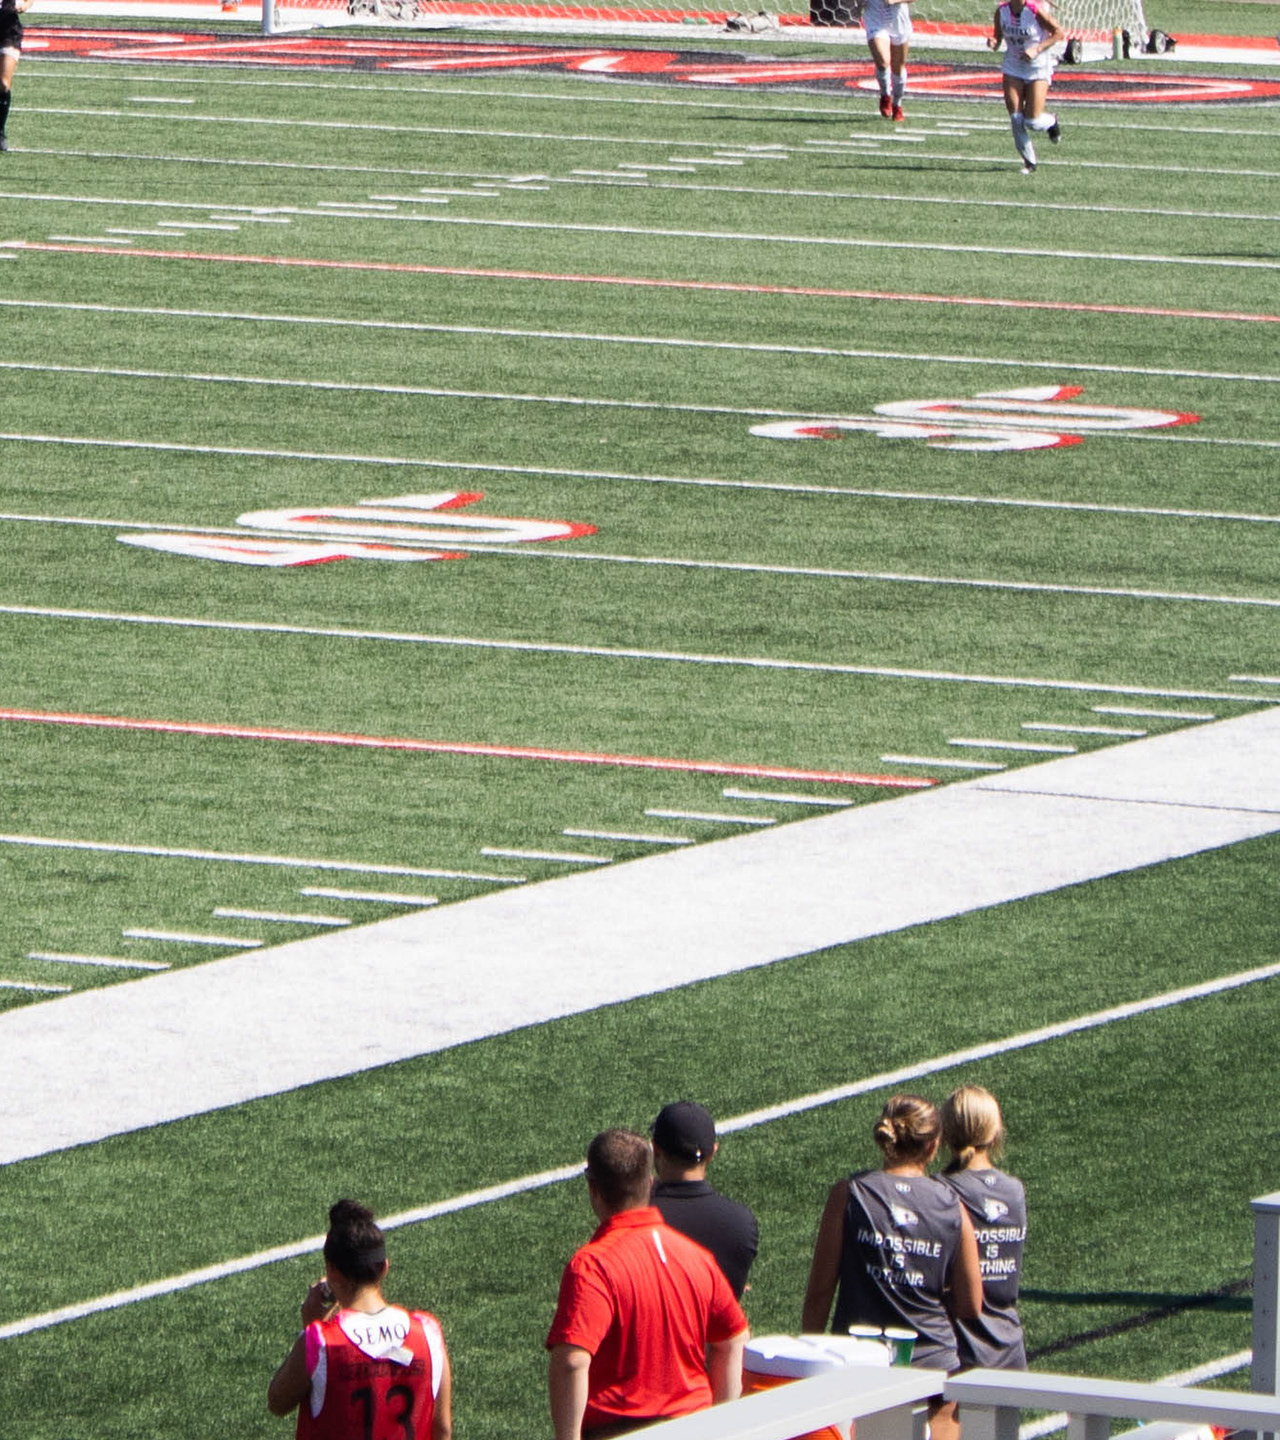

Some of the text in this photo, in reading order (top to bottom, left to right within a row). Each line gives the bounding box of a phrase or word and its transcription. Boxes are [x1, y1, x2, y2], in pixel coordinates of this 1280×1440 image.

[750, 396, 1198, 451] 30
[117, 507, 598, 567] 40
[857, 1229, 942, 1258] IMPOSSIBLE
[986, 1244, 999, 1258] IS
[979, 1259, 1017, 1275] THING.
[352, 1322, 408, 1346] SEMO
